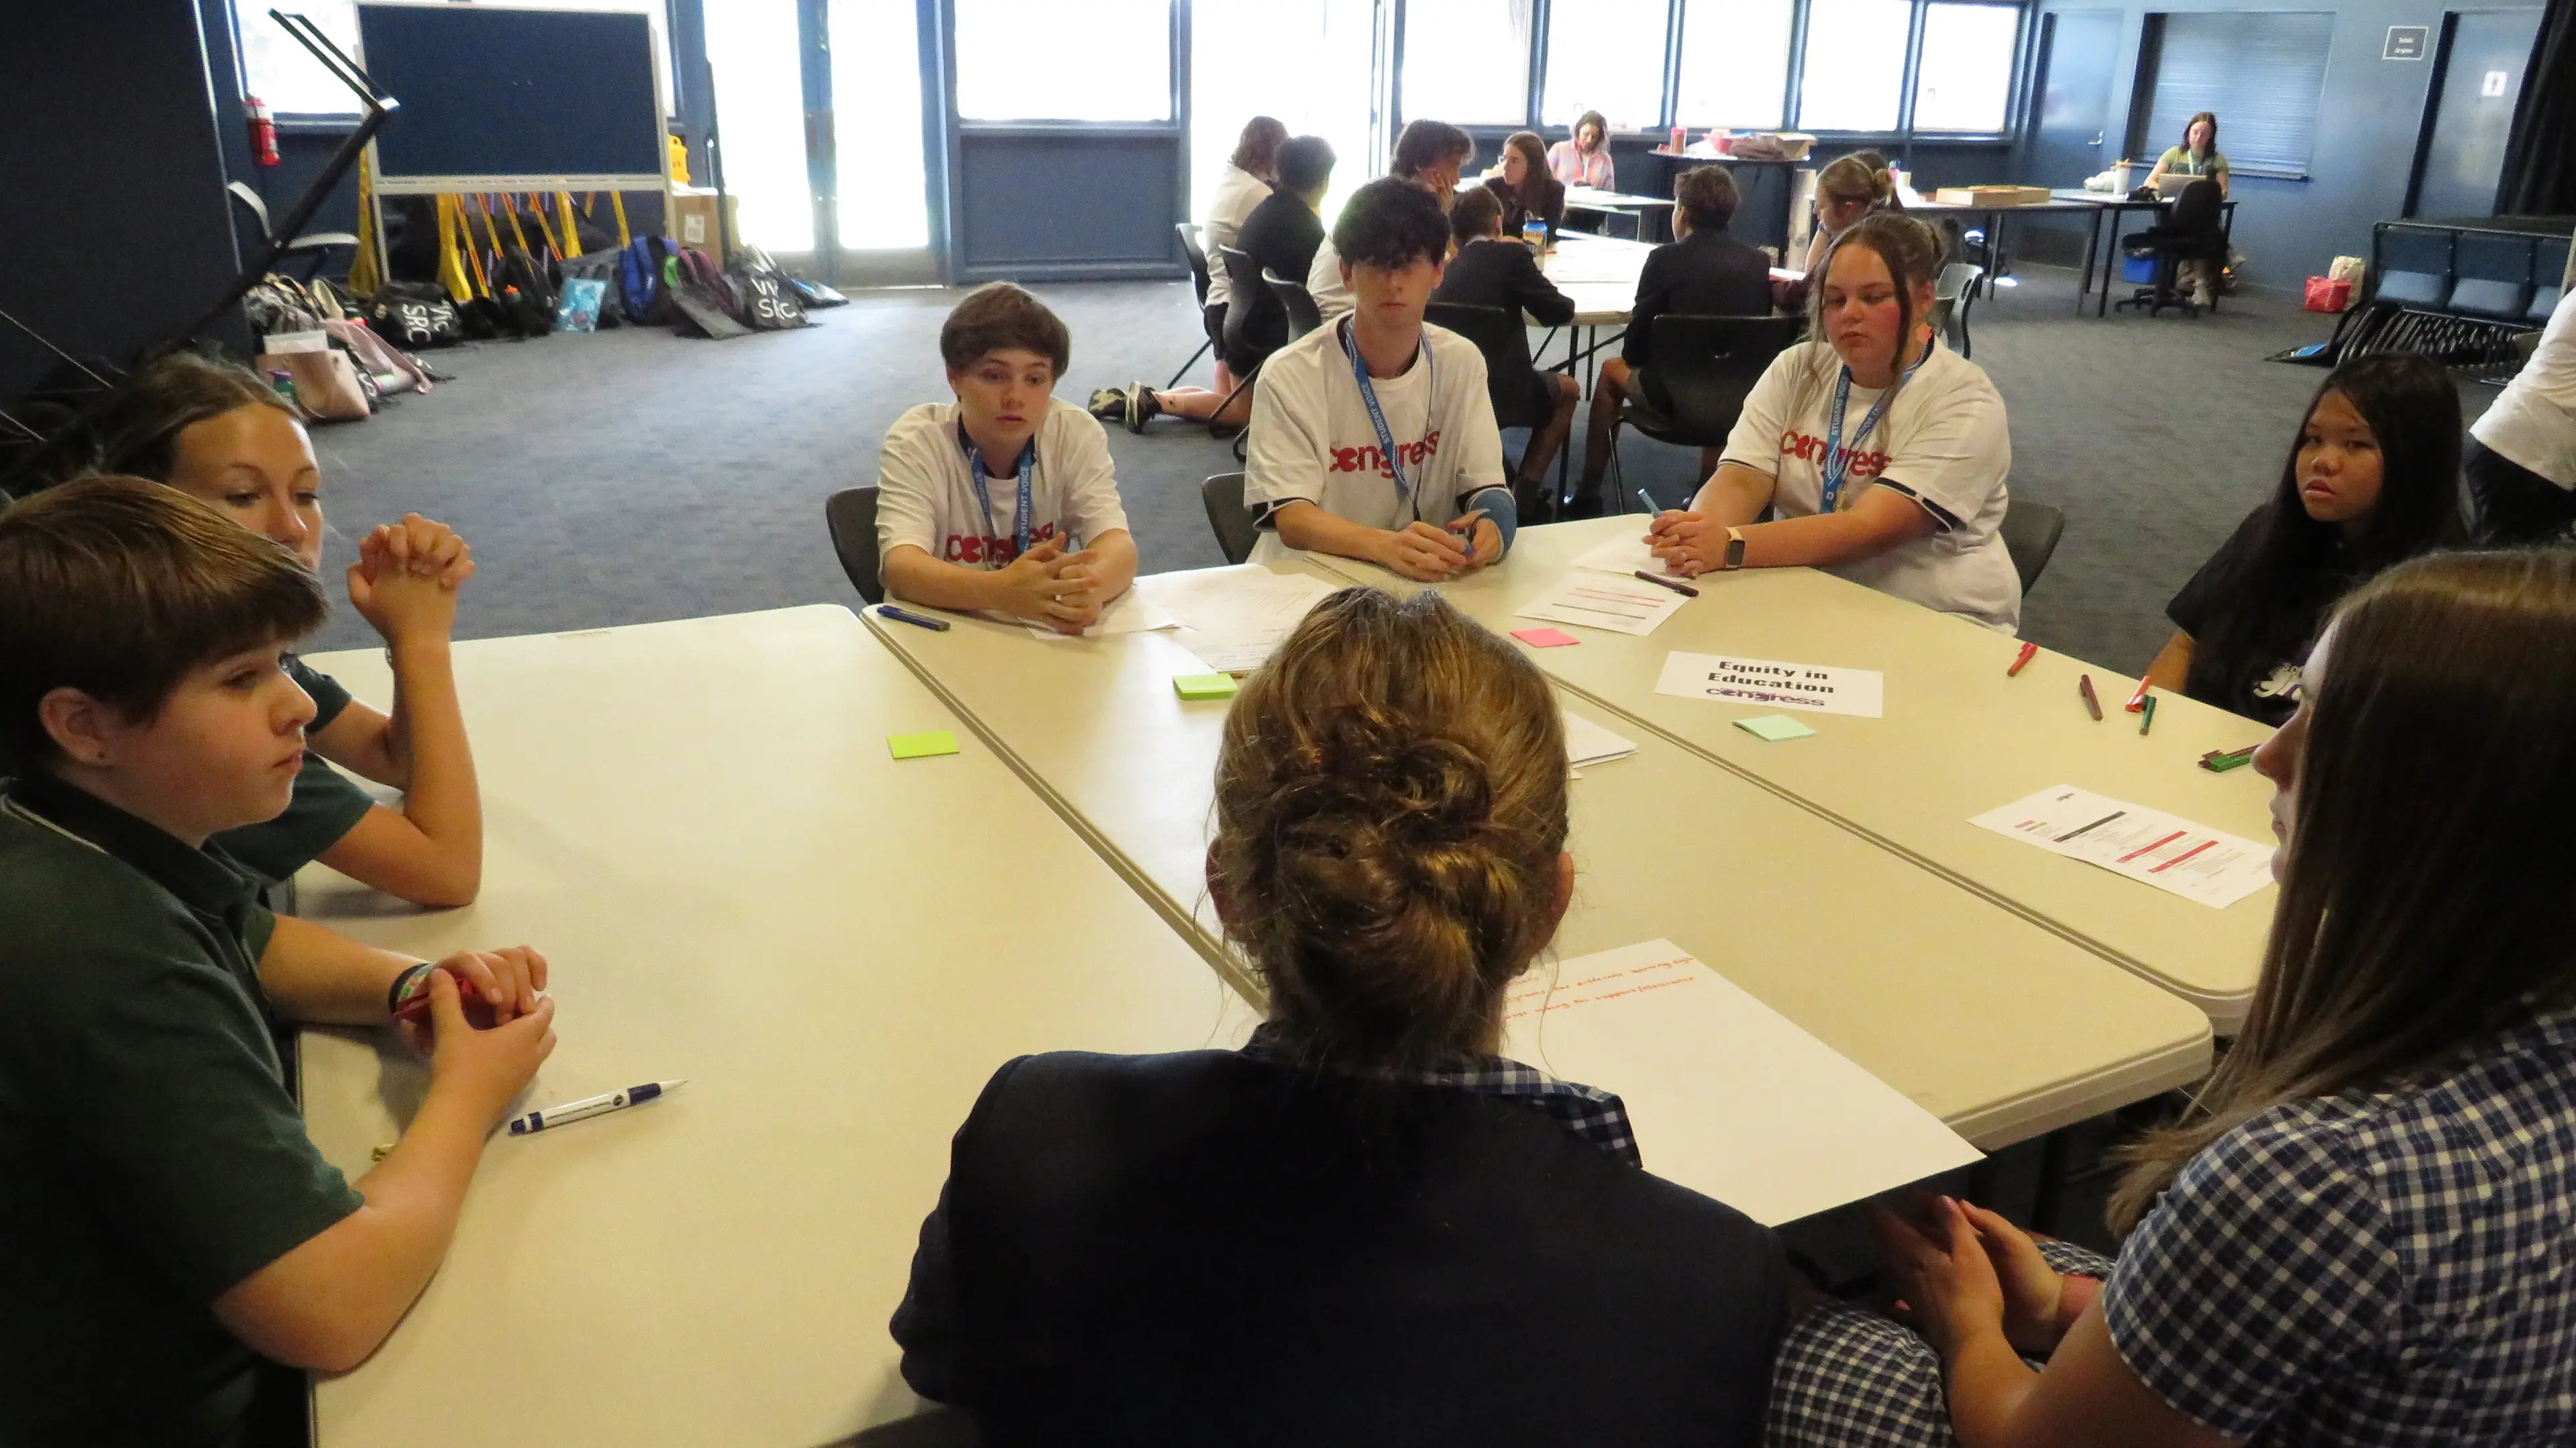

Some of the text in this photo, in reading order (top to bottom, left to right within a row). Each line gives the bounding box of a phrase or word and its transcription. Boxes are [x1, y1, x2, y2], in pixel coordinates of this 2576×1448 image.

[1371, 407, 1391, 444] STUDENT
[1020, 466, 1030, 537] STUDENT VOICE
[1708, 673, 1834, 693] Education
[1719, 662, 1829, 680] Equity in
